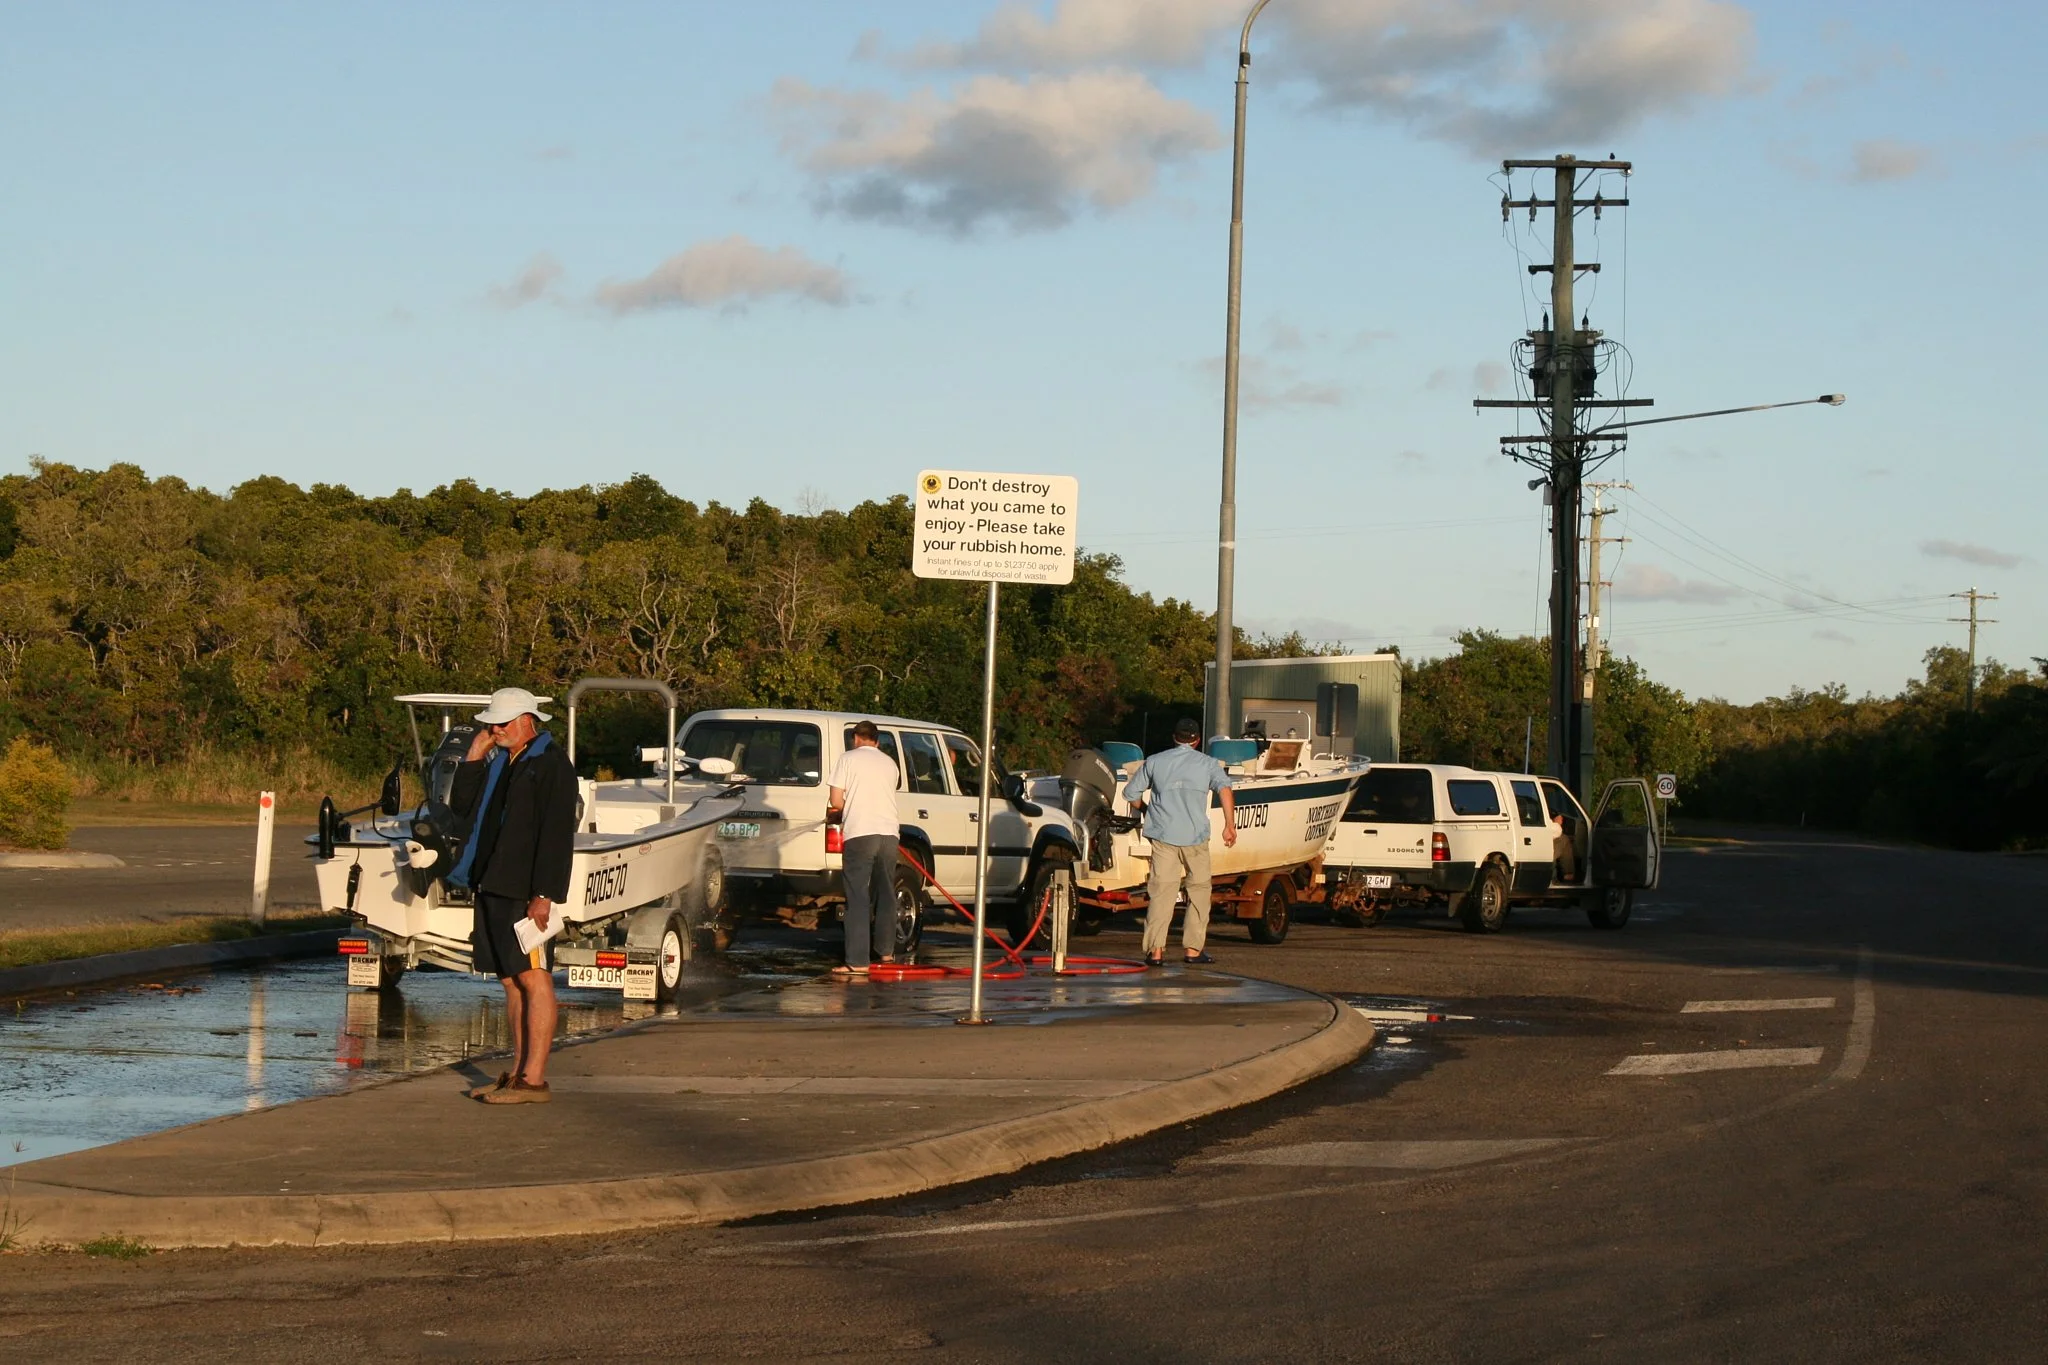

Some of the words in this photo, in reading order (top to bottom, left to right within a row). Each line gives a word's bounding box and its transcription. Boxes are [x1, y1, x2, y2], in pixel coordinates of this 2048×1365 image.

[948, 476, 987, 492] Don't
[992, 479, 1050, 497] destroy
[927, 497, 964, 511] what
[970, 501, 998, 514] you
[1003, 503, 1045, 515] came
[1051, 503, 1066, 515] to
[925, 517, 966, 534] enjoy
[977, 519, 1028, 534] Please
[1033, 522, 1066, 536] take
[923, 539, 956, 553] your
[960, 539, 1017, 554] rubbish
[1020, 541, 1066, 556] home.
[927, 557, 952, 566] Instant
[954, 558, 971, 567] fines
[973, 559, 981, 567] of
[983, 560, 992, 568] up
[995, 560, 1003, 568] to
[1038, 562, 1059, 572] apply
[937, 567, 948, 576] for
[950, 568, 980, 577] unlawful
[982, 569, 1013, 579] disposal
[1660, 782, 1672, 790] 60
